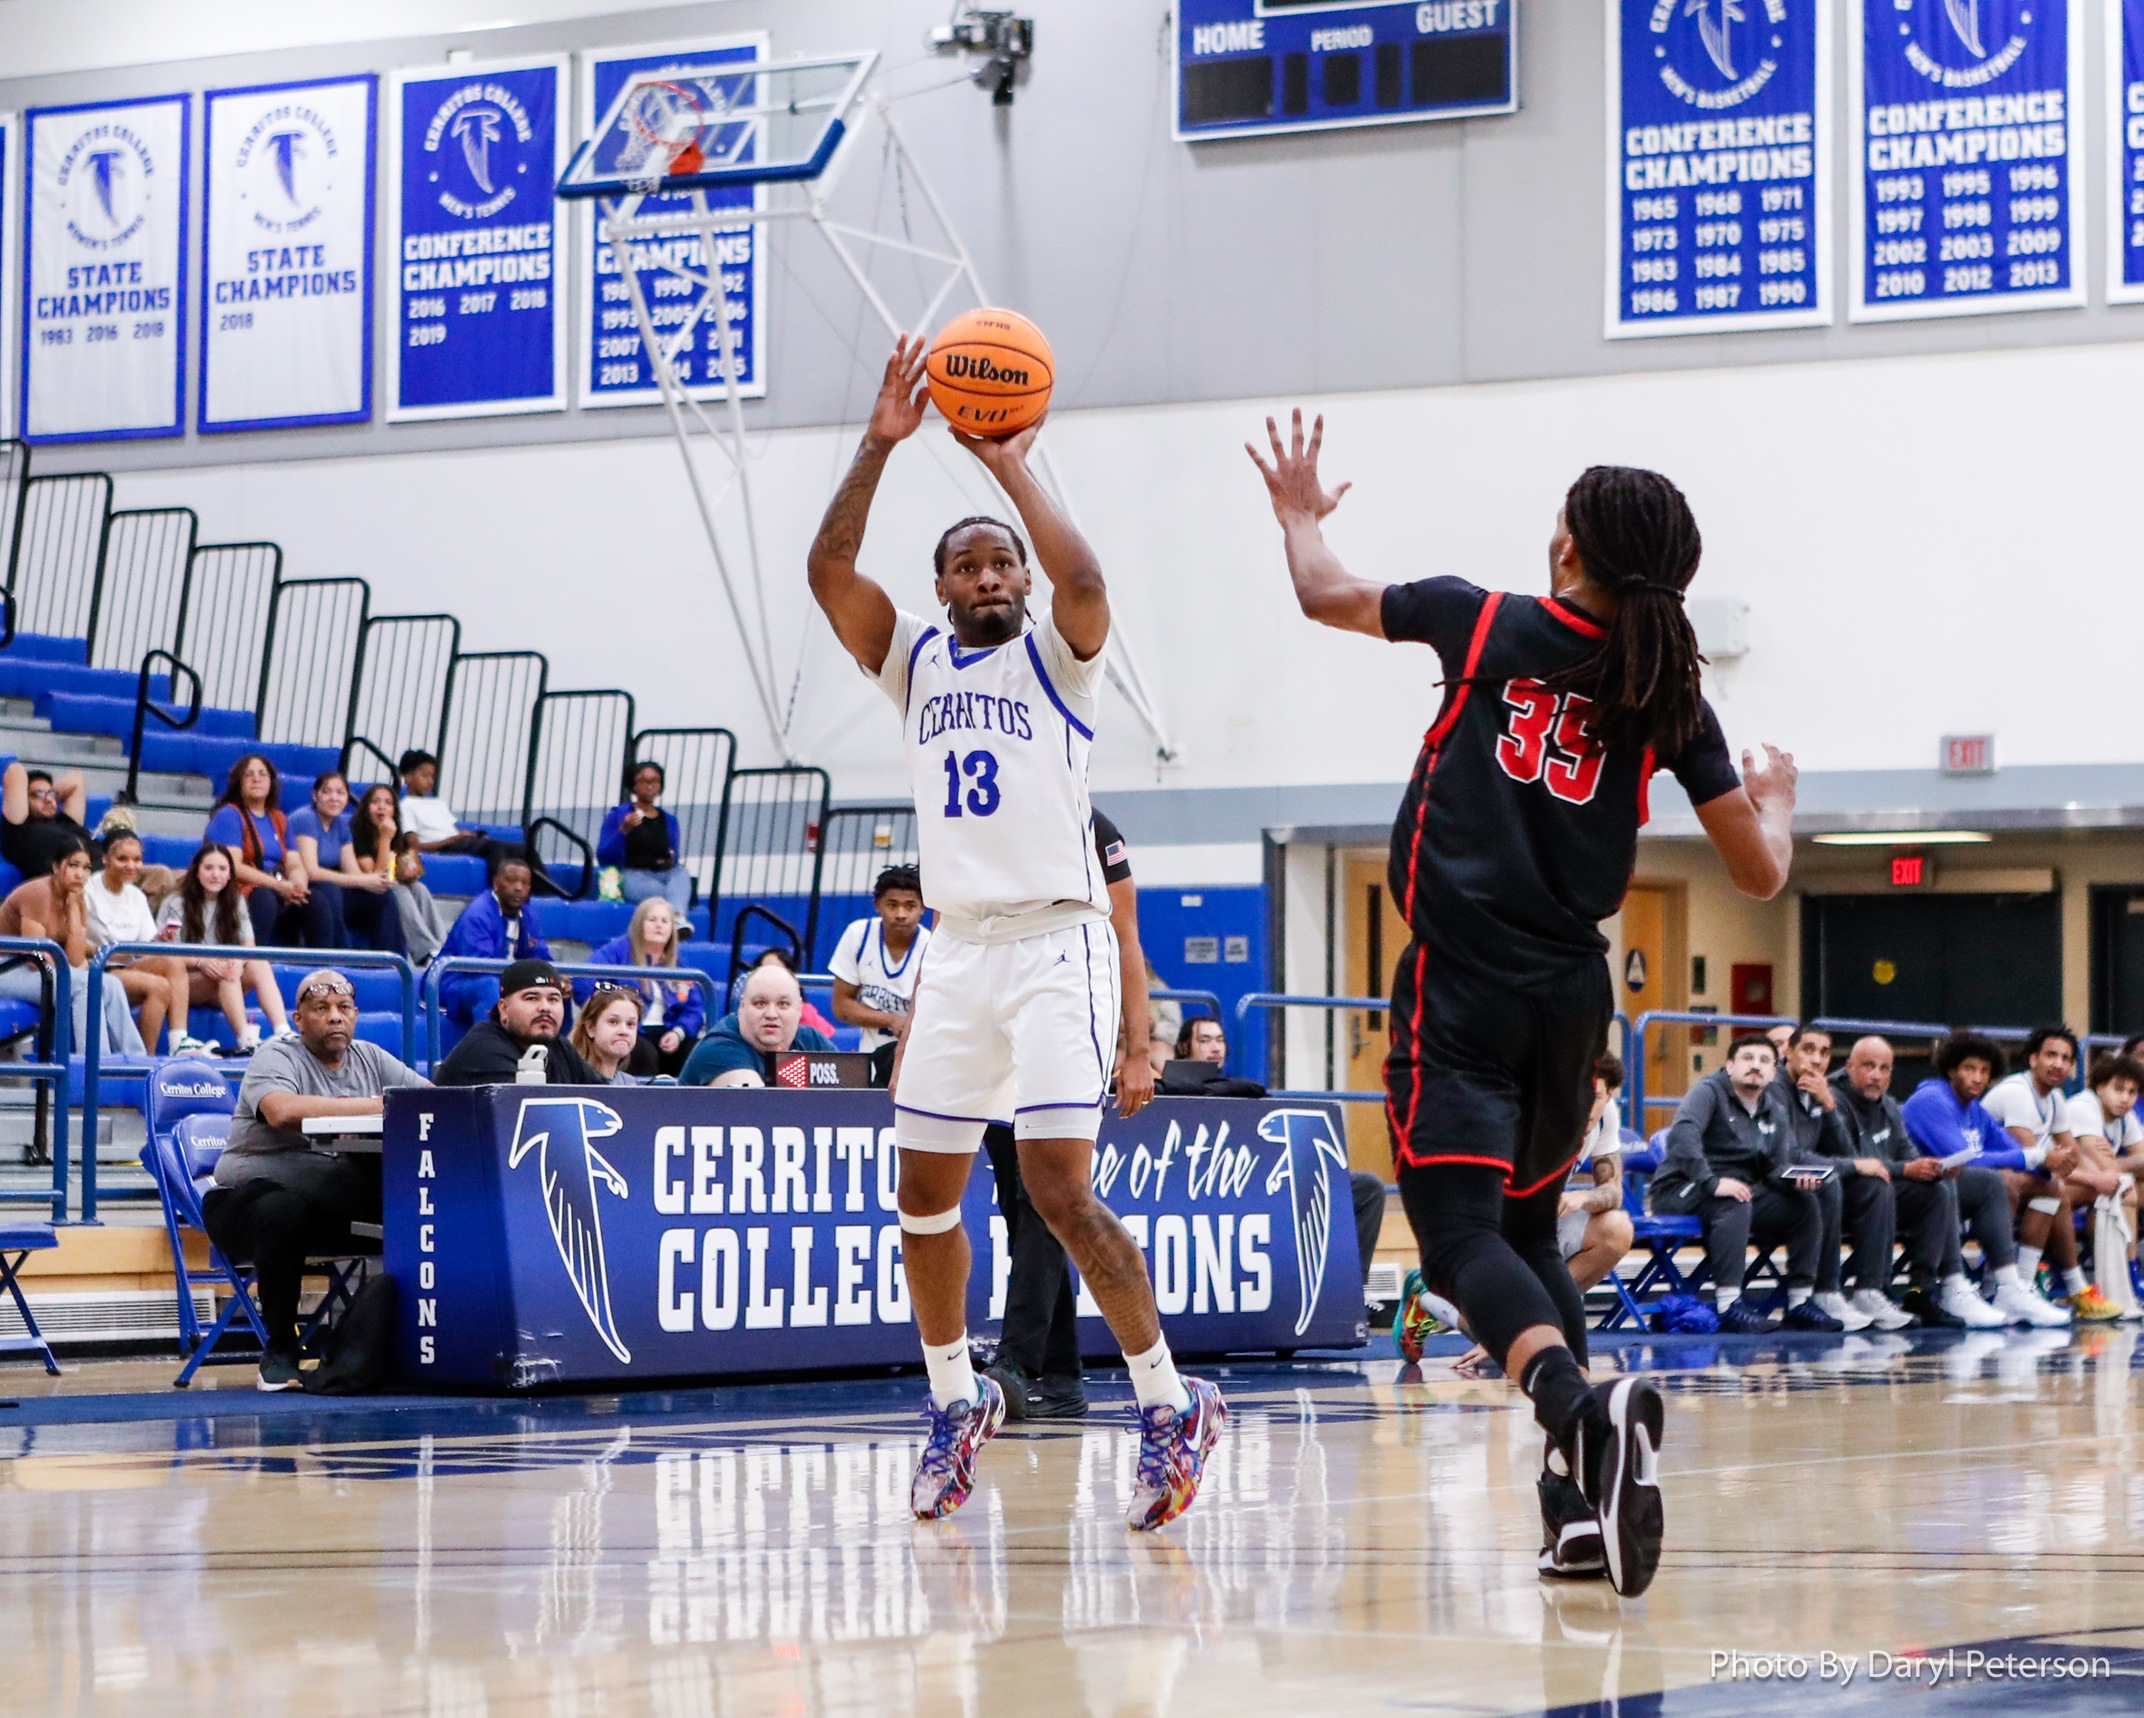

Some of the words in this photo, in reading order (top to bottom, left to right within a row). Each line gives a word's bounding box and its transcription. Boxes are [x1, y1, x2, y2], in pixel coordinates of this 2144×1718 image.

[1415, 0, 1500, 33] GUEST
[1192, 20, 1266, 56] HOME
[1310, 25, 1374, 52] PERIOD
[1868, 89, 2065, 137] CONFERENCE
[1625, 112, 1813, 157] CONFERENCE
[1868, 122, 2067, 172] CHAMPIONS
[1625, 145, 1814, 191] CHAMPIONS
[1876, 174, 1925, 203] 1993
[1942, 169, 1991, 198] 1995
[2009, 163, 2060, 192] 1996
[1876, 206, 1925, 235] 1997
[1942, 200, 1992, 229] 1998
[2009, 195, 2060, 224] 1999
[247, 244, 325, 274] STATE
[403, 223, 551, 260] CONFERENCE
[1874, 237, 1927, 266] 2002
[1939, 232, 1994, 262] 2003
[2006, 226, 2062, 256] 2009
[67, 261, 142, 289] STATE
[215, 270, 357, 305] CHAMPIONS
[403, 254, 551, 291] CHAMPIONS
[1876, 268, 1926, 298] 2010
[1943, 263, 1994, 292] 2012
[2009, 258, 2060, 287] 2013
[37, 287, 171, 320] CHAMPIONS
[408, 296, 446, 319] 2016
[459, 291, 497, 315] 2017
[510, 287, 547, 310] 2018
[41, 327, 73, 346] 1983
[86, 324, 118, 343] 2016
[132, 321, 164, 340] 2018
[219, 312, 254, 331] 2018
[408, 323, 447, 347] 2019
[598, 335, 641, 358] 2007
[600, 362, 639, 385] 2013
[945, 353, 1029, 387] Wilson
[1495, 677, 1608, 806] 35
[1948, 738, 1985, 769] EXIT
[944, 749, 1002, 818] 13
[1891, 857, 1924, 885] EXIT
[160, 1082, 193, 1095] Cerritos
[193, 1083, 227, 1098] College
[810, 1063, 840, 1084] POSS.
[190, 1135, 228, 1147] Cerritos
[653, 1125, 900, 1215] CERRITO
[1128, 1118, 1182, 1202] of
[1185, 1119, 1261, 1201] the
[417, 1112, 437, 1364] FALCONS
[657, 1224, 912, 1333] COLLEG
